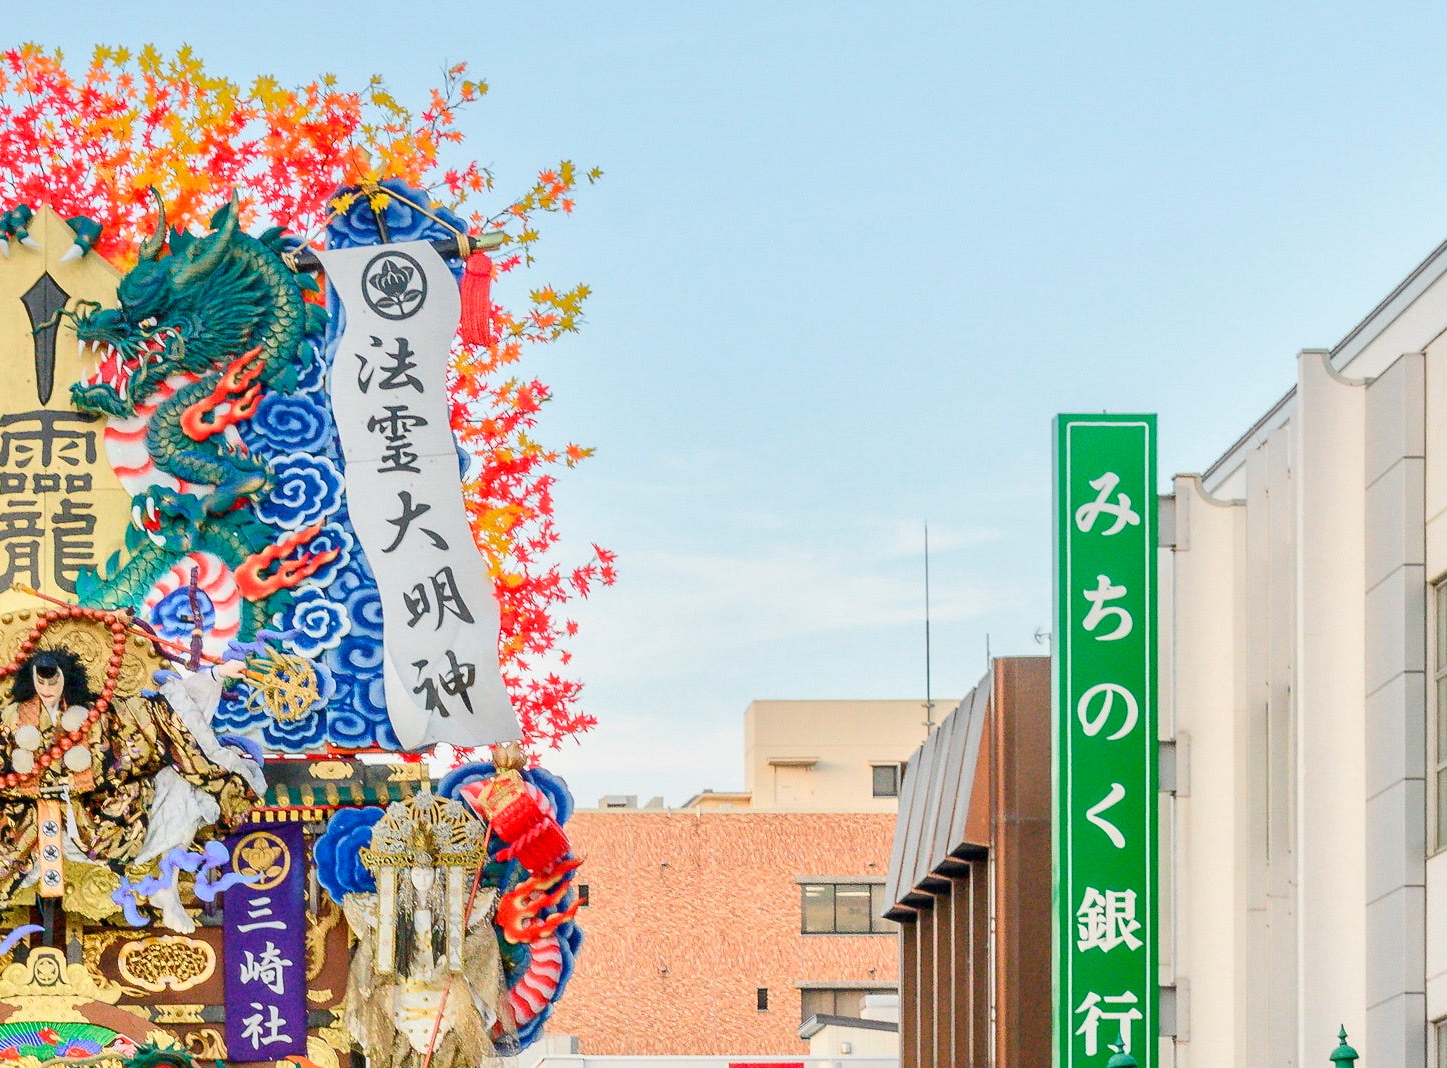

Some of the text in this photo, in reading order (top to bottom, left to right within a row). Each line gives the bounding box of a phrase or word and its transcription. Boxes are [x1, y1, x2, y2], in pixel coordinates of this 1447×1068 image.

[1074, 471, 1142, 1056] みちのく銀行
[236, 896, 294, 1051] 三崎社
